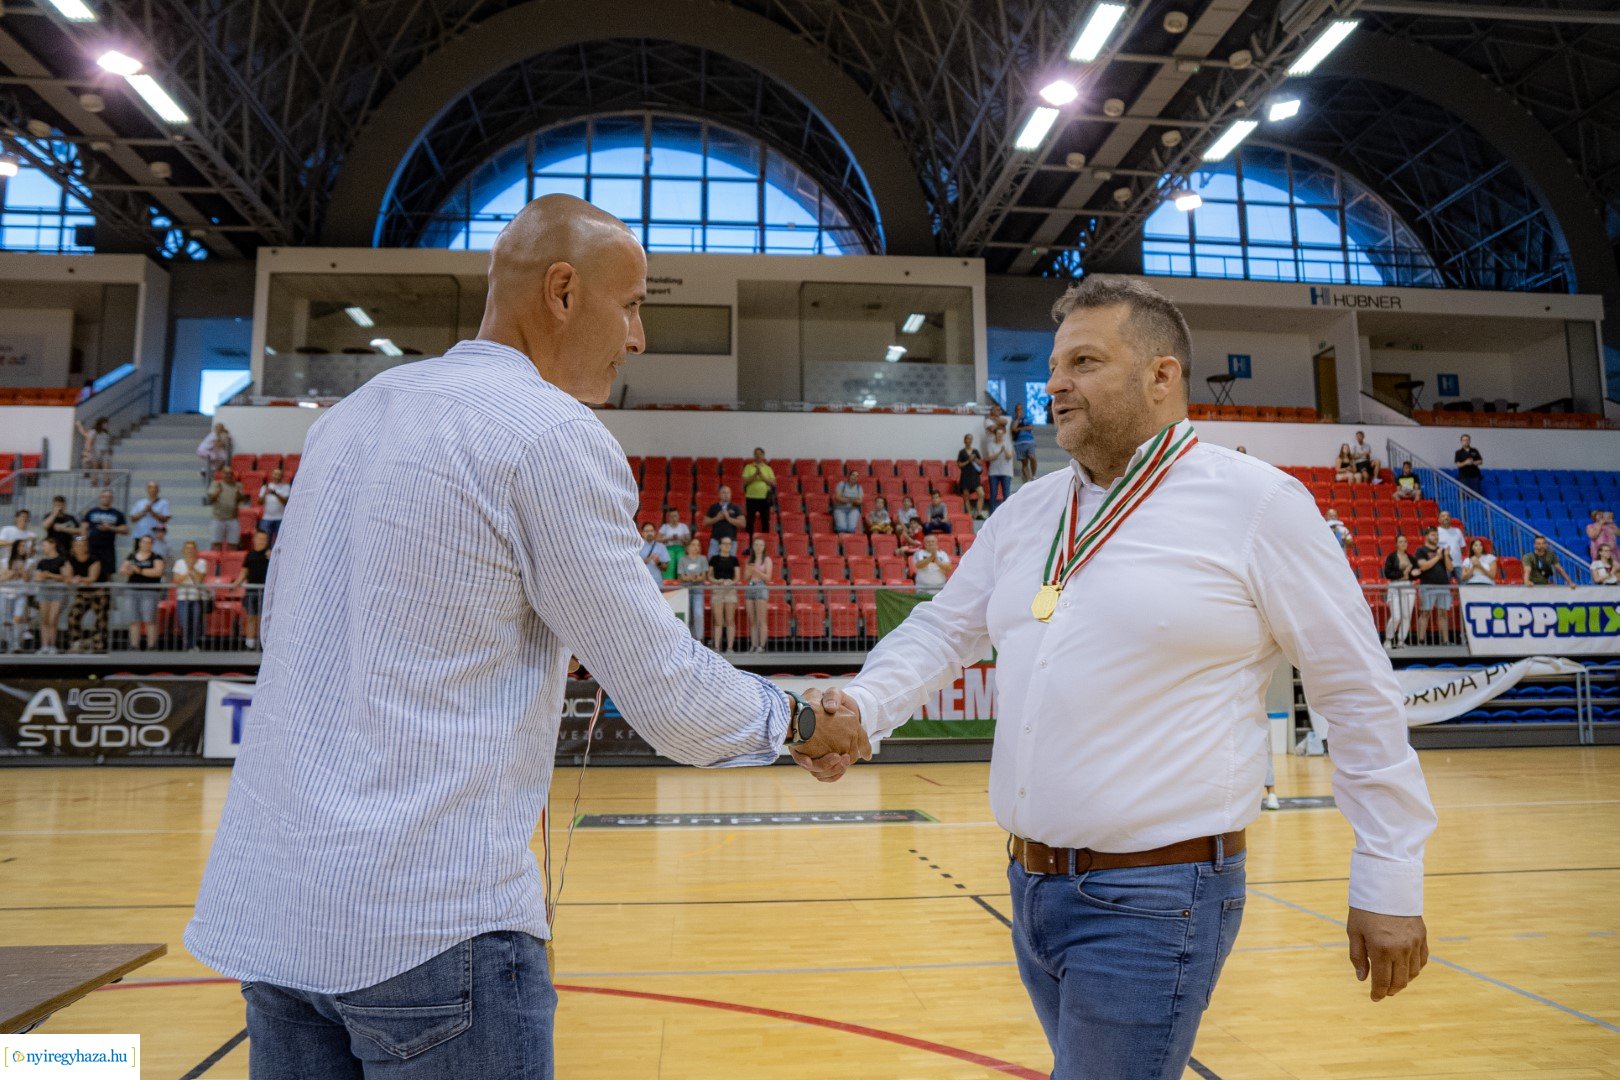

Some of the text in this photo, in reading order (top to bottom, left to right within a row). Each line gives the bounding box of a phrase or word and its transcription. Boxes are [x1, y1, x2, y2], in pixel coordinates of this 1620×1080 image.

[1333, 293, 1402, 309] HÜBNER
[1404, 676, 1477, 705] RMA
[17, 725, 171, 748] STUDIO
